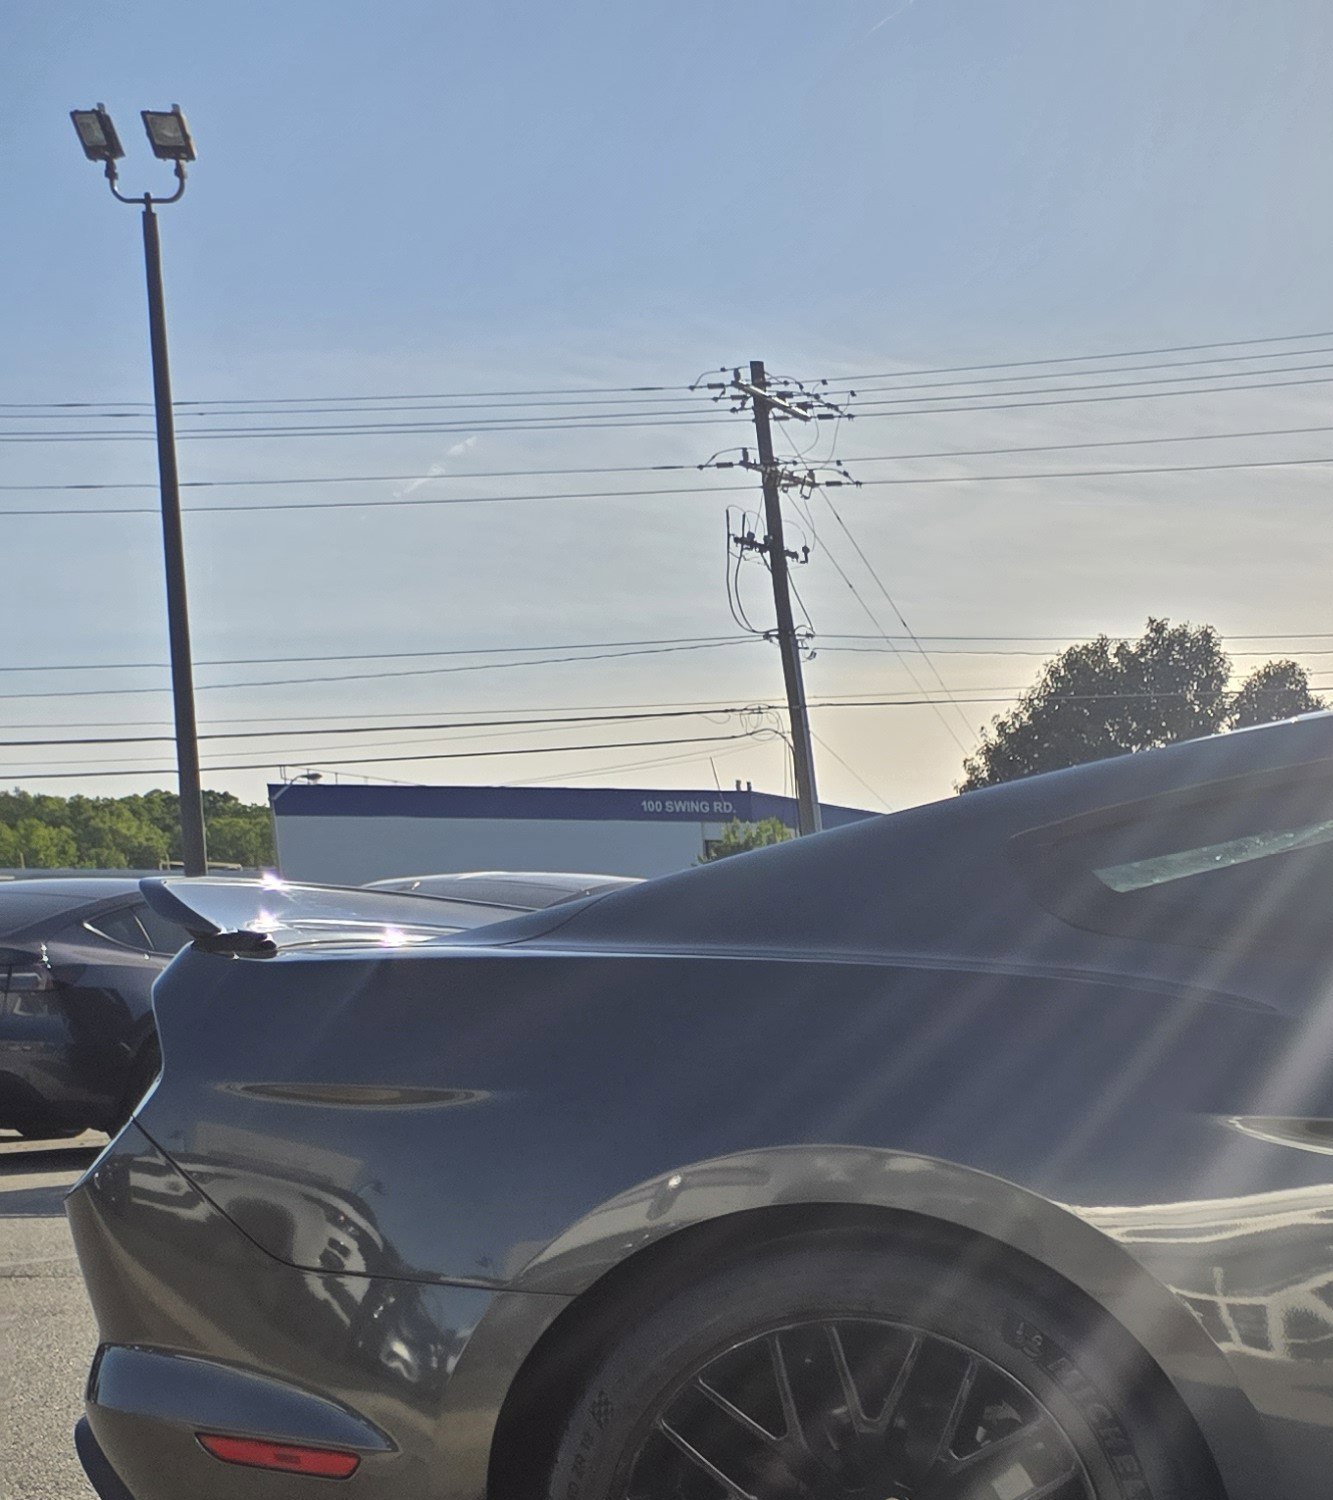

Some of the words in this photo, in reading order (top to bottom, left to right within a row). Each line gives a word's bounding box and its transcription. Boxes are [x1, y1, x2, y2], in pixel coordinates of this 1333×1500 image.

[641, 800, 662, 812] 100
[665, 800, 710, 813] SWING
[713, 801, 736, 814] RD.
